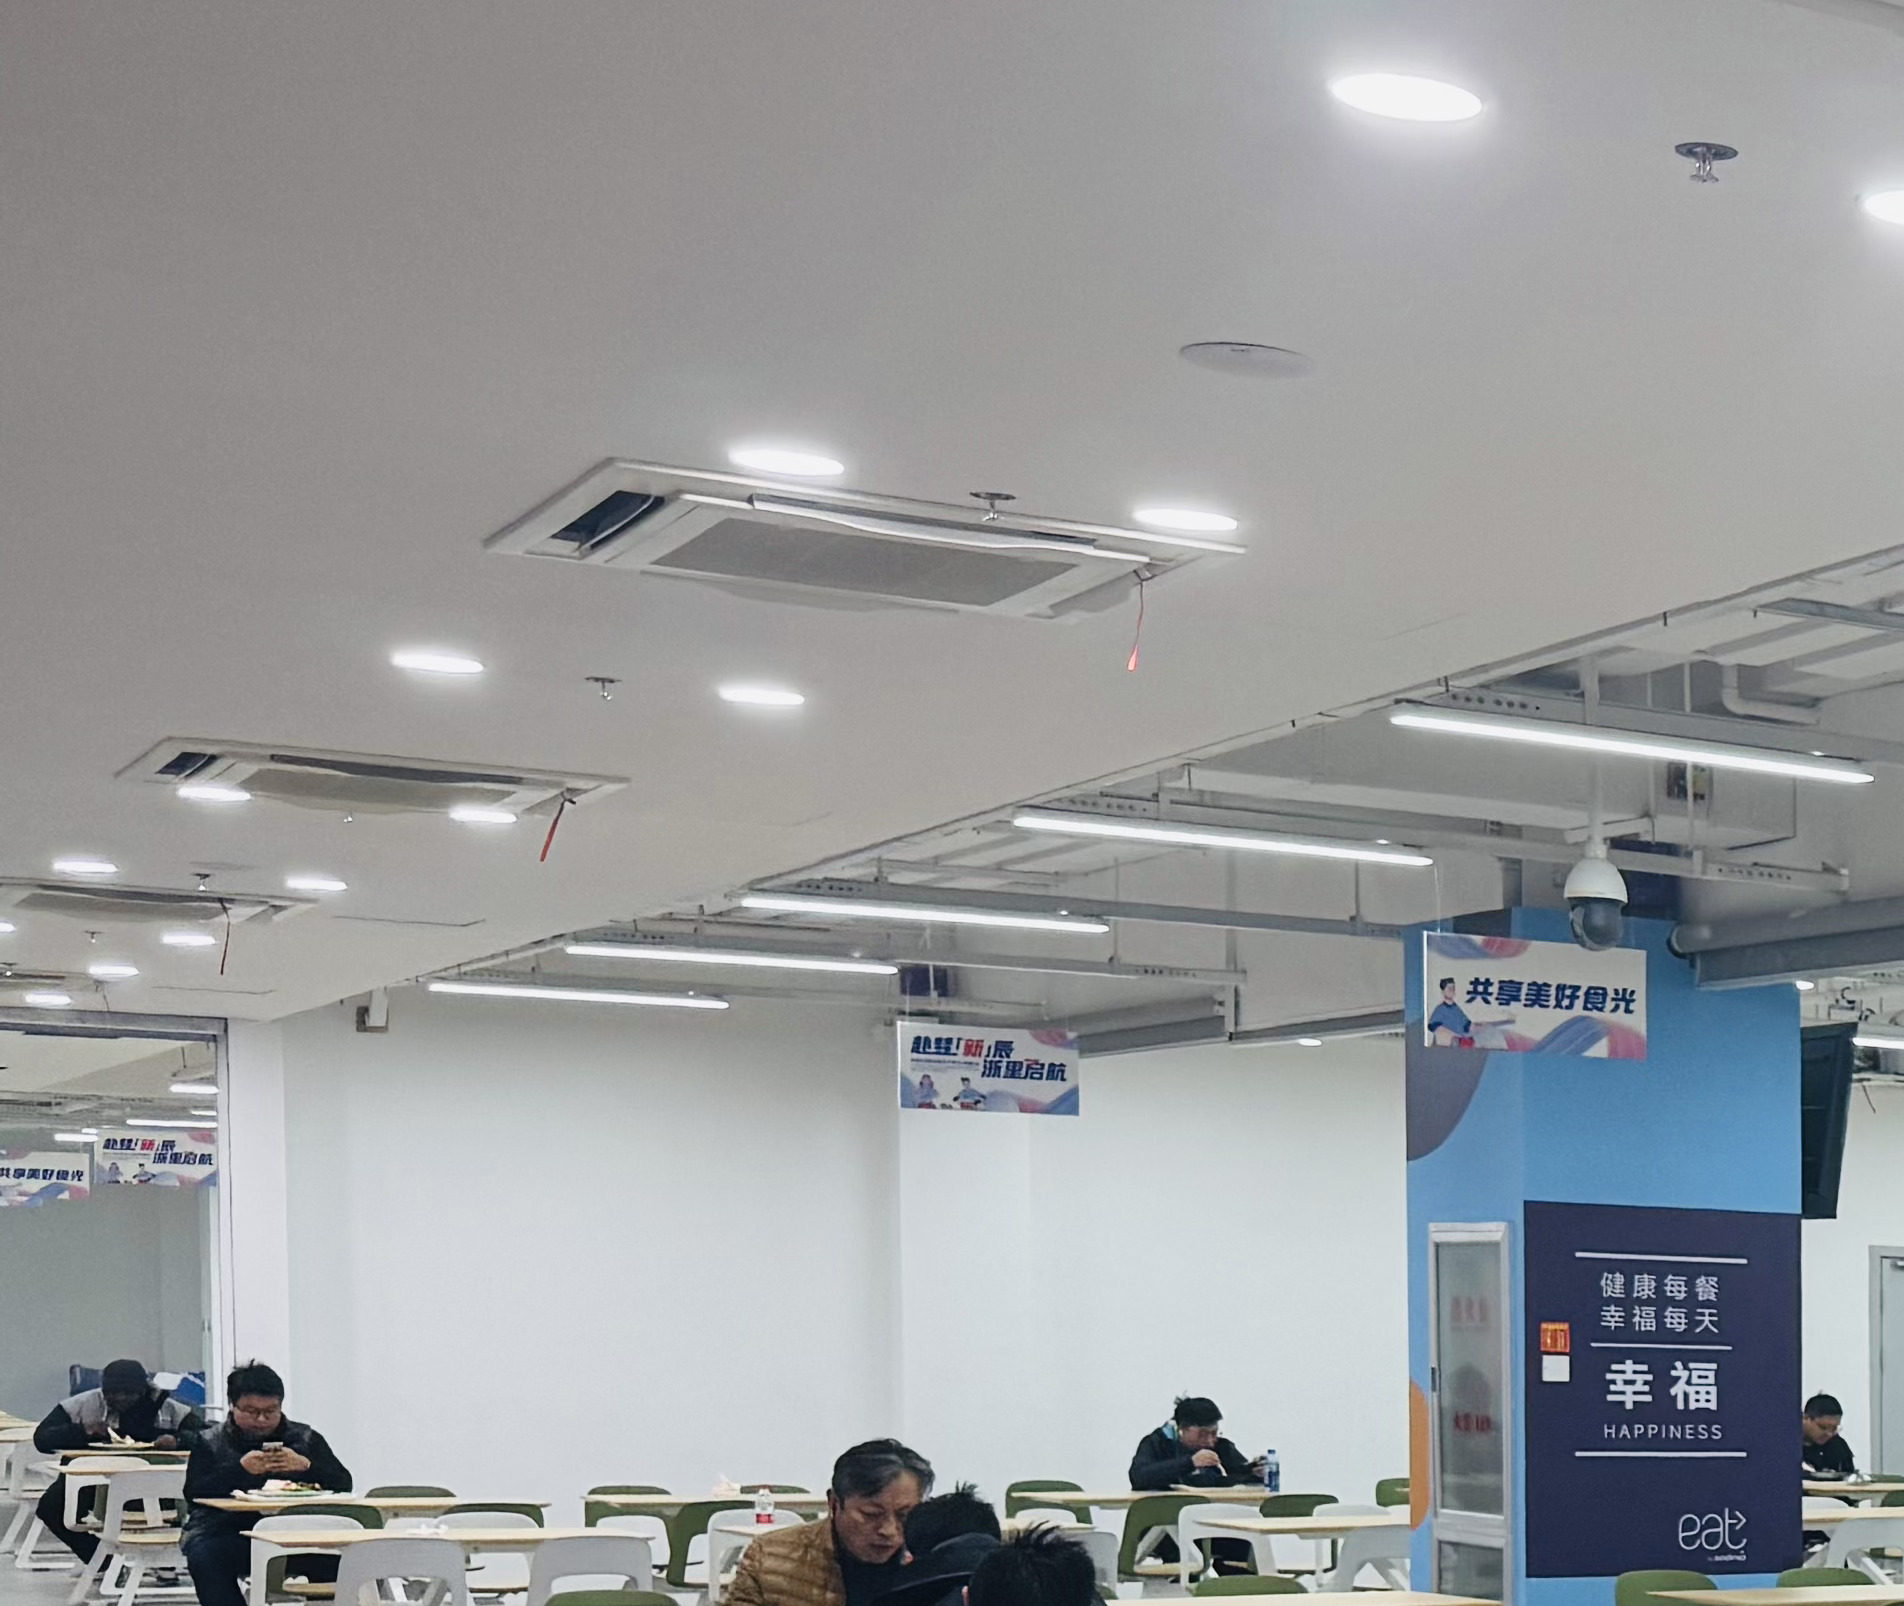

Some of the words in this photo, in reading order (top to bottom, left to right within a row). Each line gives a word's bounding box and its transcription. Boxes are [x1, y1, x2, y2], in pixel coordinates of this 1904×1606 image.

[1465, 977, 1637, 1014] 共享美好食光
[981, 1058, 1068, 1082] 浙里启航
[1600, 1272, 1720, 1302] 健康每餐
[1600, 1304, 1720, 1334] 幸福每天
[1605, 1359, 1719, 1411] 幸福
[1603, 1423, 1723, 1441] HAPPINESS
[1678, 1507, 1747, 1551] eat
